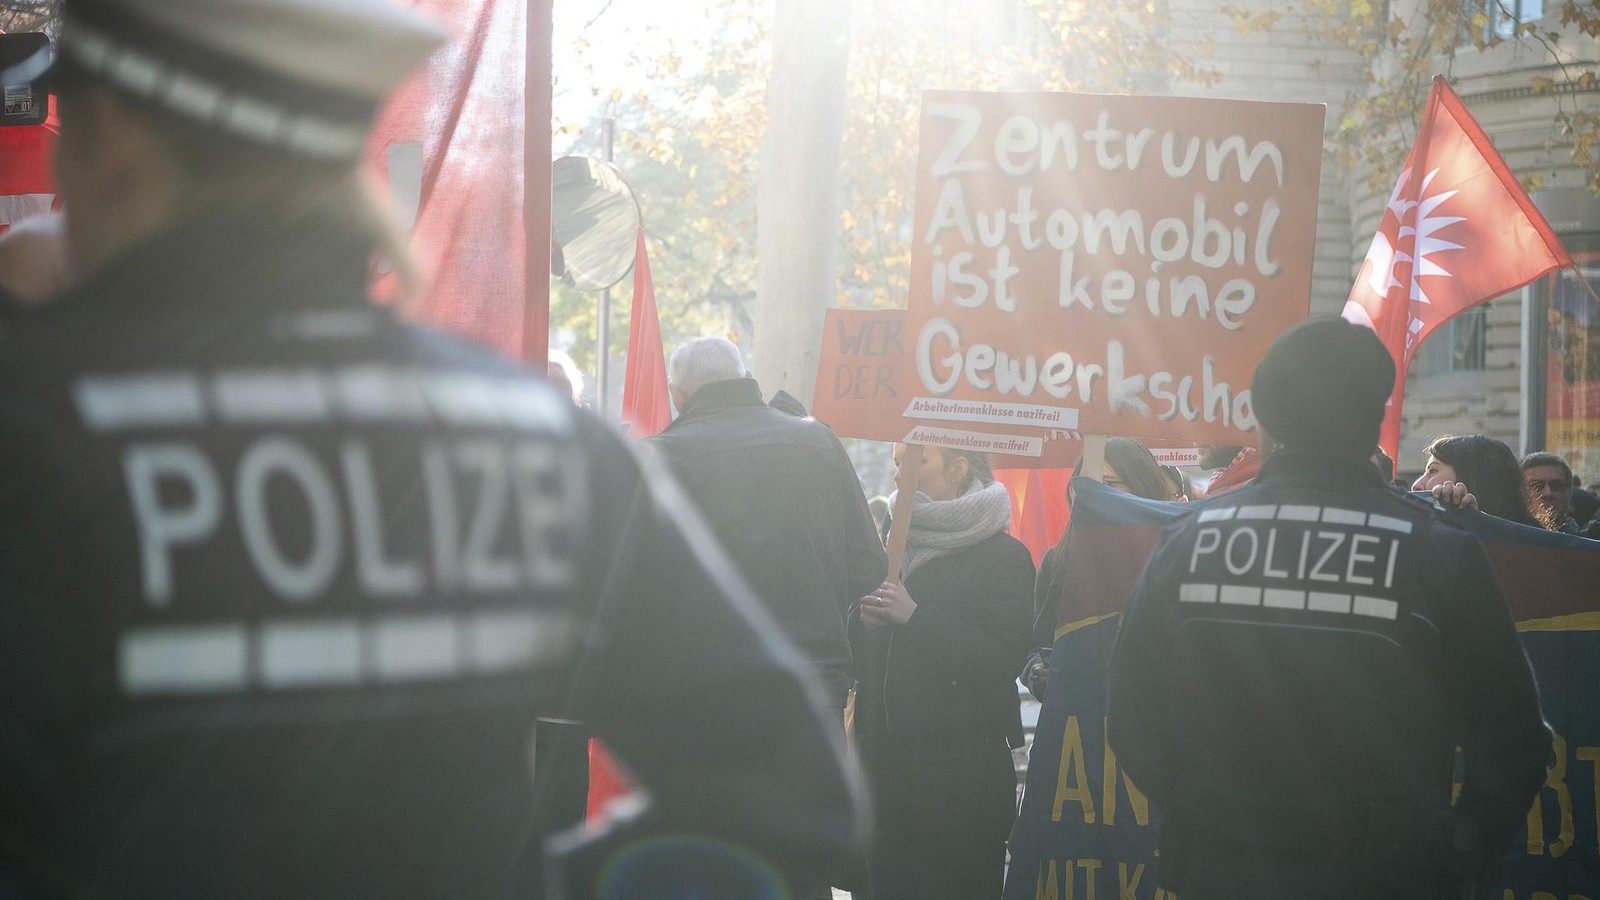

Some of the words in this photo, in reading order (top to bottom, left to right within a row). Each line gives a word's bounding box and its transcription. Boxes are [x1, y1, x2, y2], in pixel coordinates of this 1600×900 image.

[927, 103, 1284, 189] Zentrum
[925, 179, 1281, 276] Automobil
[931, 246, 1020, 312] ist
[1059, 249, 1256, 330] keine
[836, 316, 904, 357] WER
[832, 363, 898, 400] DER
[915, 316, 1257, 432] Gewerkscha
[911, 431, 991, 448] ArbeiterInnenklasse
[993, 440, 1029, 452] nazifrei!
[912, 401, 1014, 417] ArbeiterInnenklasse
[1016, 409, 1060, 422] nazifrei!
[1189, 526, 1399, 588] POLIZEI
[1050, 715, 1149, 826] AN
